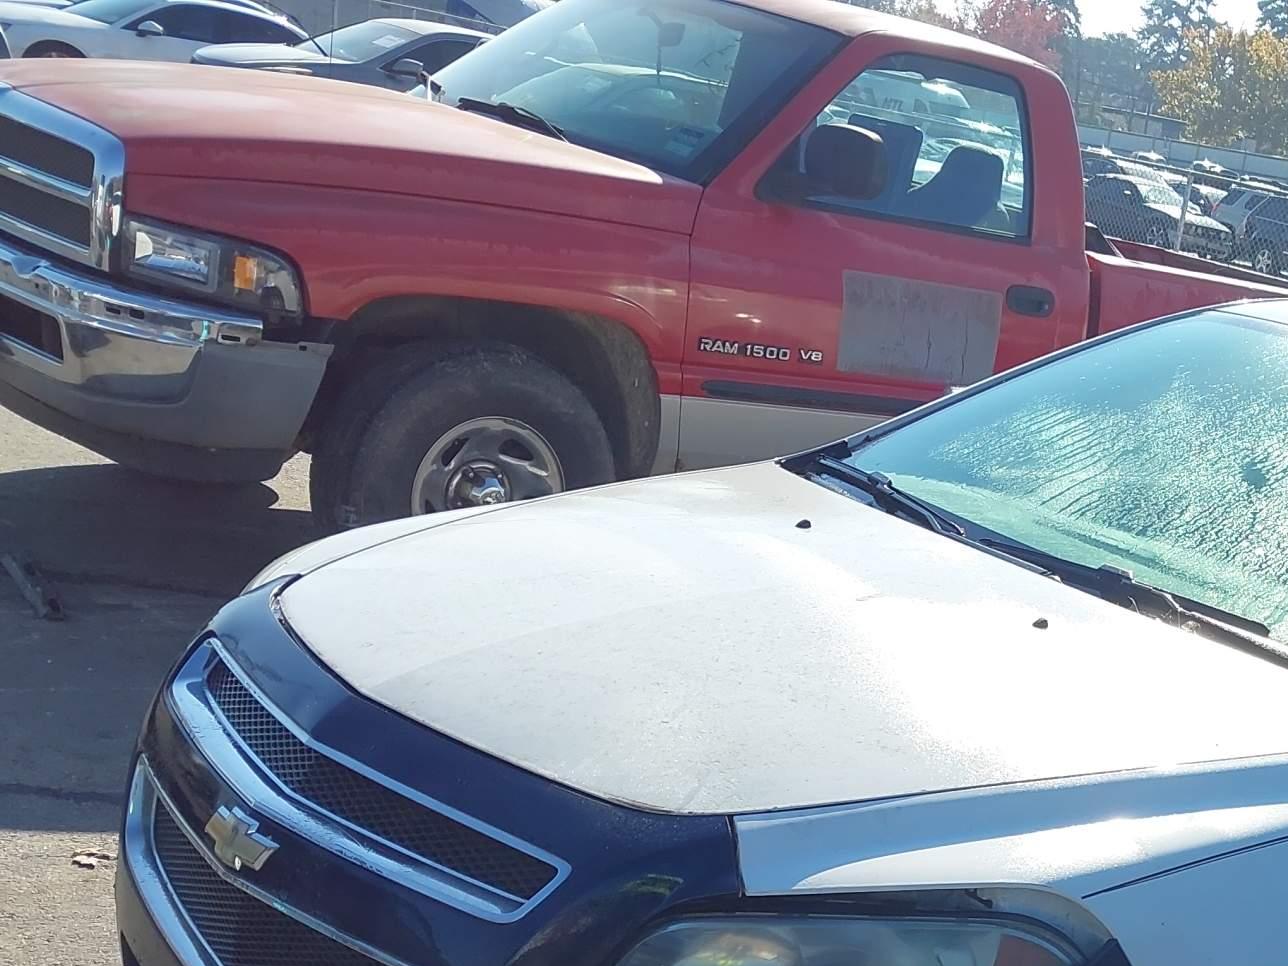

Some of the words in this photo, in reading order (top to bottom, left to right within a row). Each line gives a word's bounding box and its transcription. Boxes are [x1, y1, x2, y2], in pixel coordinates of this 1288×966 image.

[700, 338, 739, 355] RAM
[745, 344, 791, 361] 1500
[800, 349, 823, 362] V8
